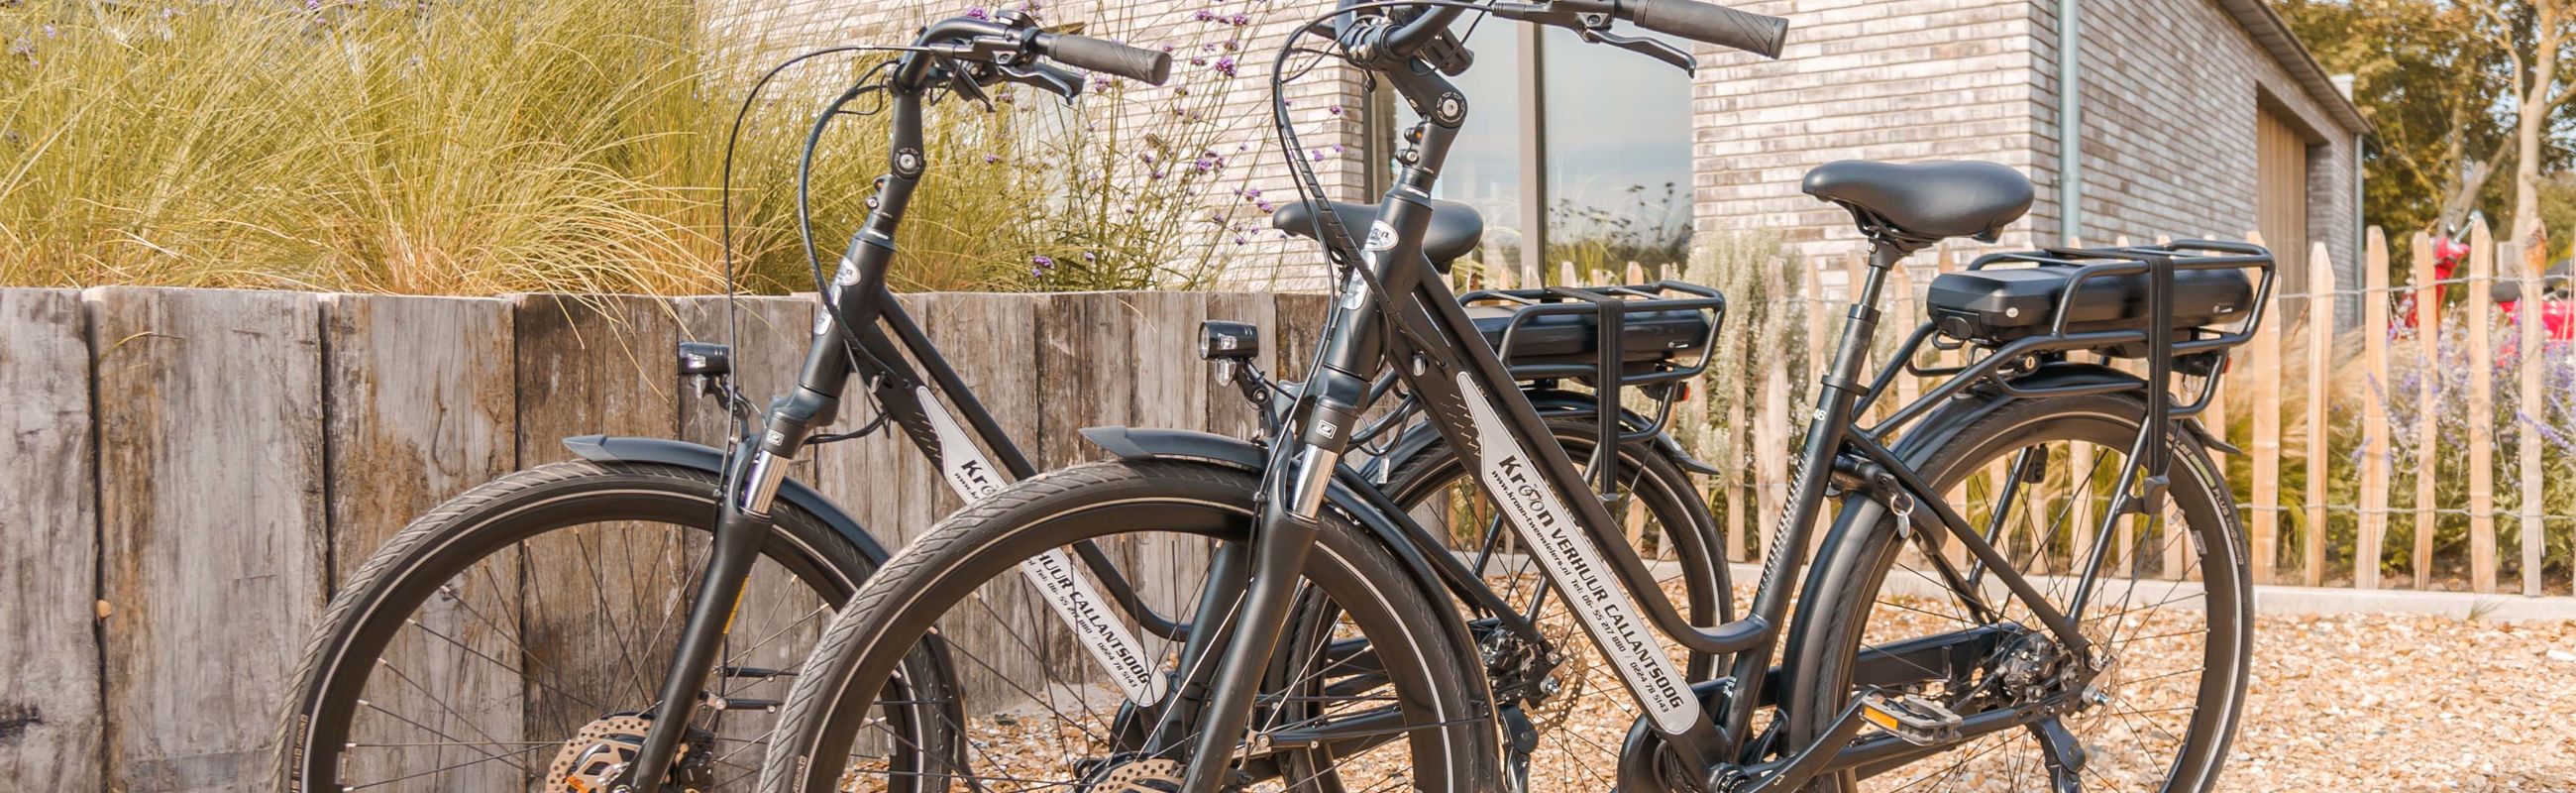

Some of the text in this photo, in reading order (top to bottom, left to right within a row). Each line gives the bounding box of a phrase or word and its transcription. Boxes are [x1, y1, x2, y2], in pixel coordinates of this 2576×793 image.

[1037, 553, 1073, 589] HUUR
[1069, 591, 1150, 684] CALLANTSOOG
[1097, 642, 1115, 660] 0224
[1491, 470, 1571, 576] www.kroon-tweewielers.nl
[1571, 579, 1583, 594] Tel:
[1582, 595, 1594, 609] 06-
[1593, 610, 1605, 622] 55
[1601, 623, 1614, 635] 217
[1612, 636, 1626, 652] 880
[1630, 661, 1647, 682] 0224
[1646, 683, 1656, 694] 78
[1653, 694, 1669, 713] 5143
[1499, 455, 1684, 709] Kroon VERHUUR CALLANTSOOG
